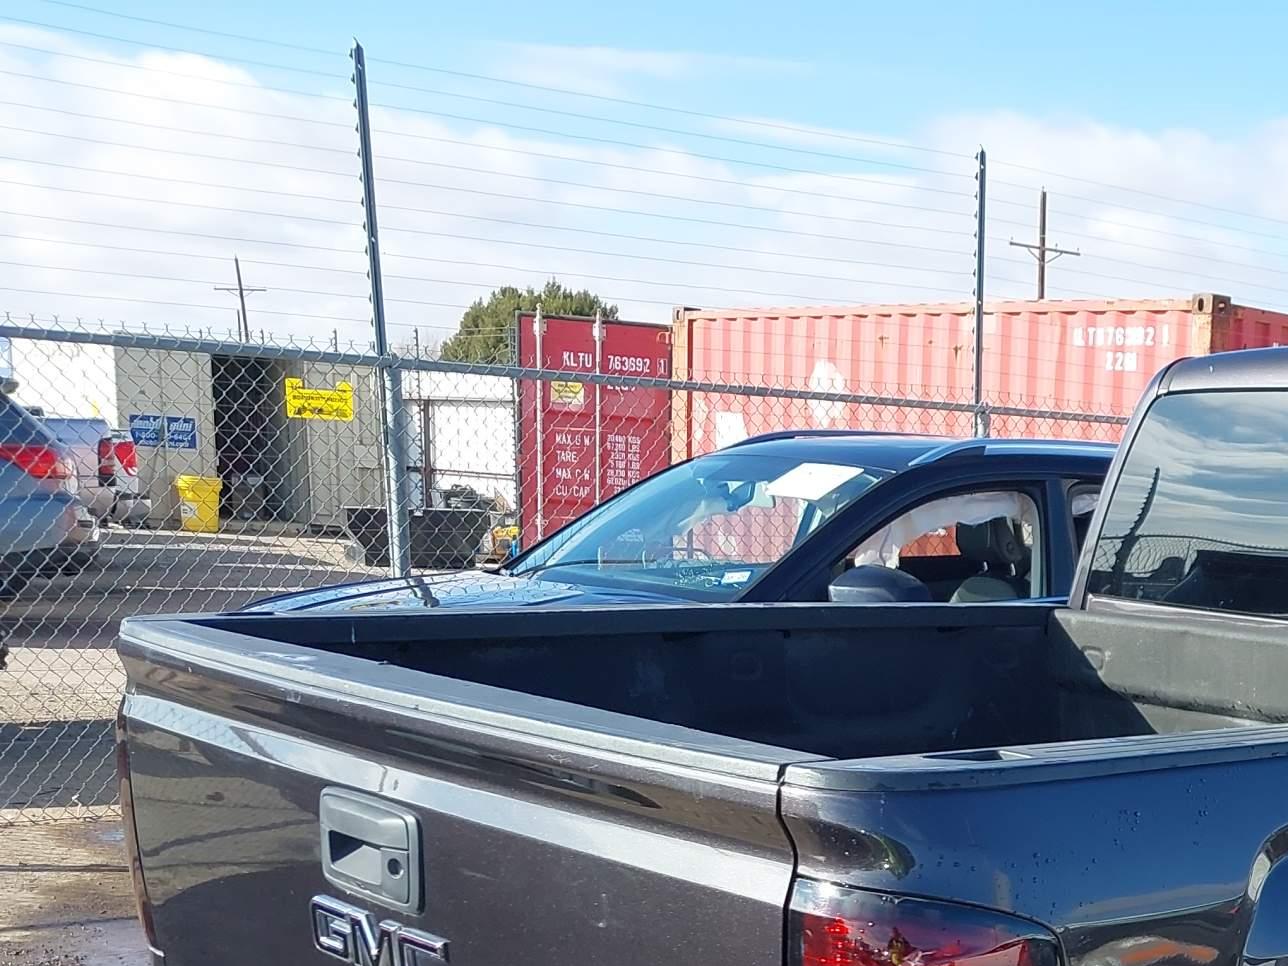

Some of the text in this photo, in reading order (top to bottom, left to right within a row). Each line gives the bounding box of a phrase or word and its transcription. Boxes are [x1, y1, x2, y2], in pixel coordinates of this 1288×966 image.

[562, 351, 593, 368] KLTU
[608, 355, 650, 373] 763692
[556, 450, 577, 462] TARE
[556, 484, 568, 496] CU
